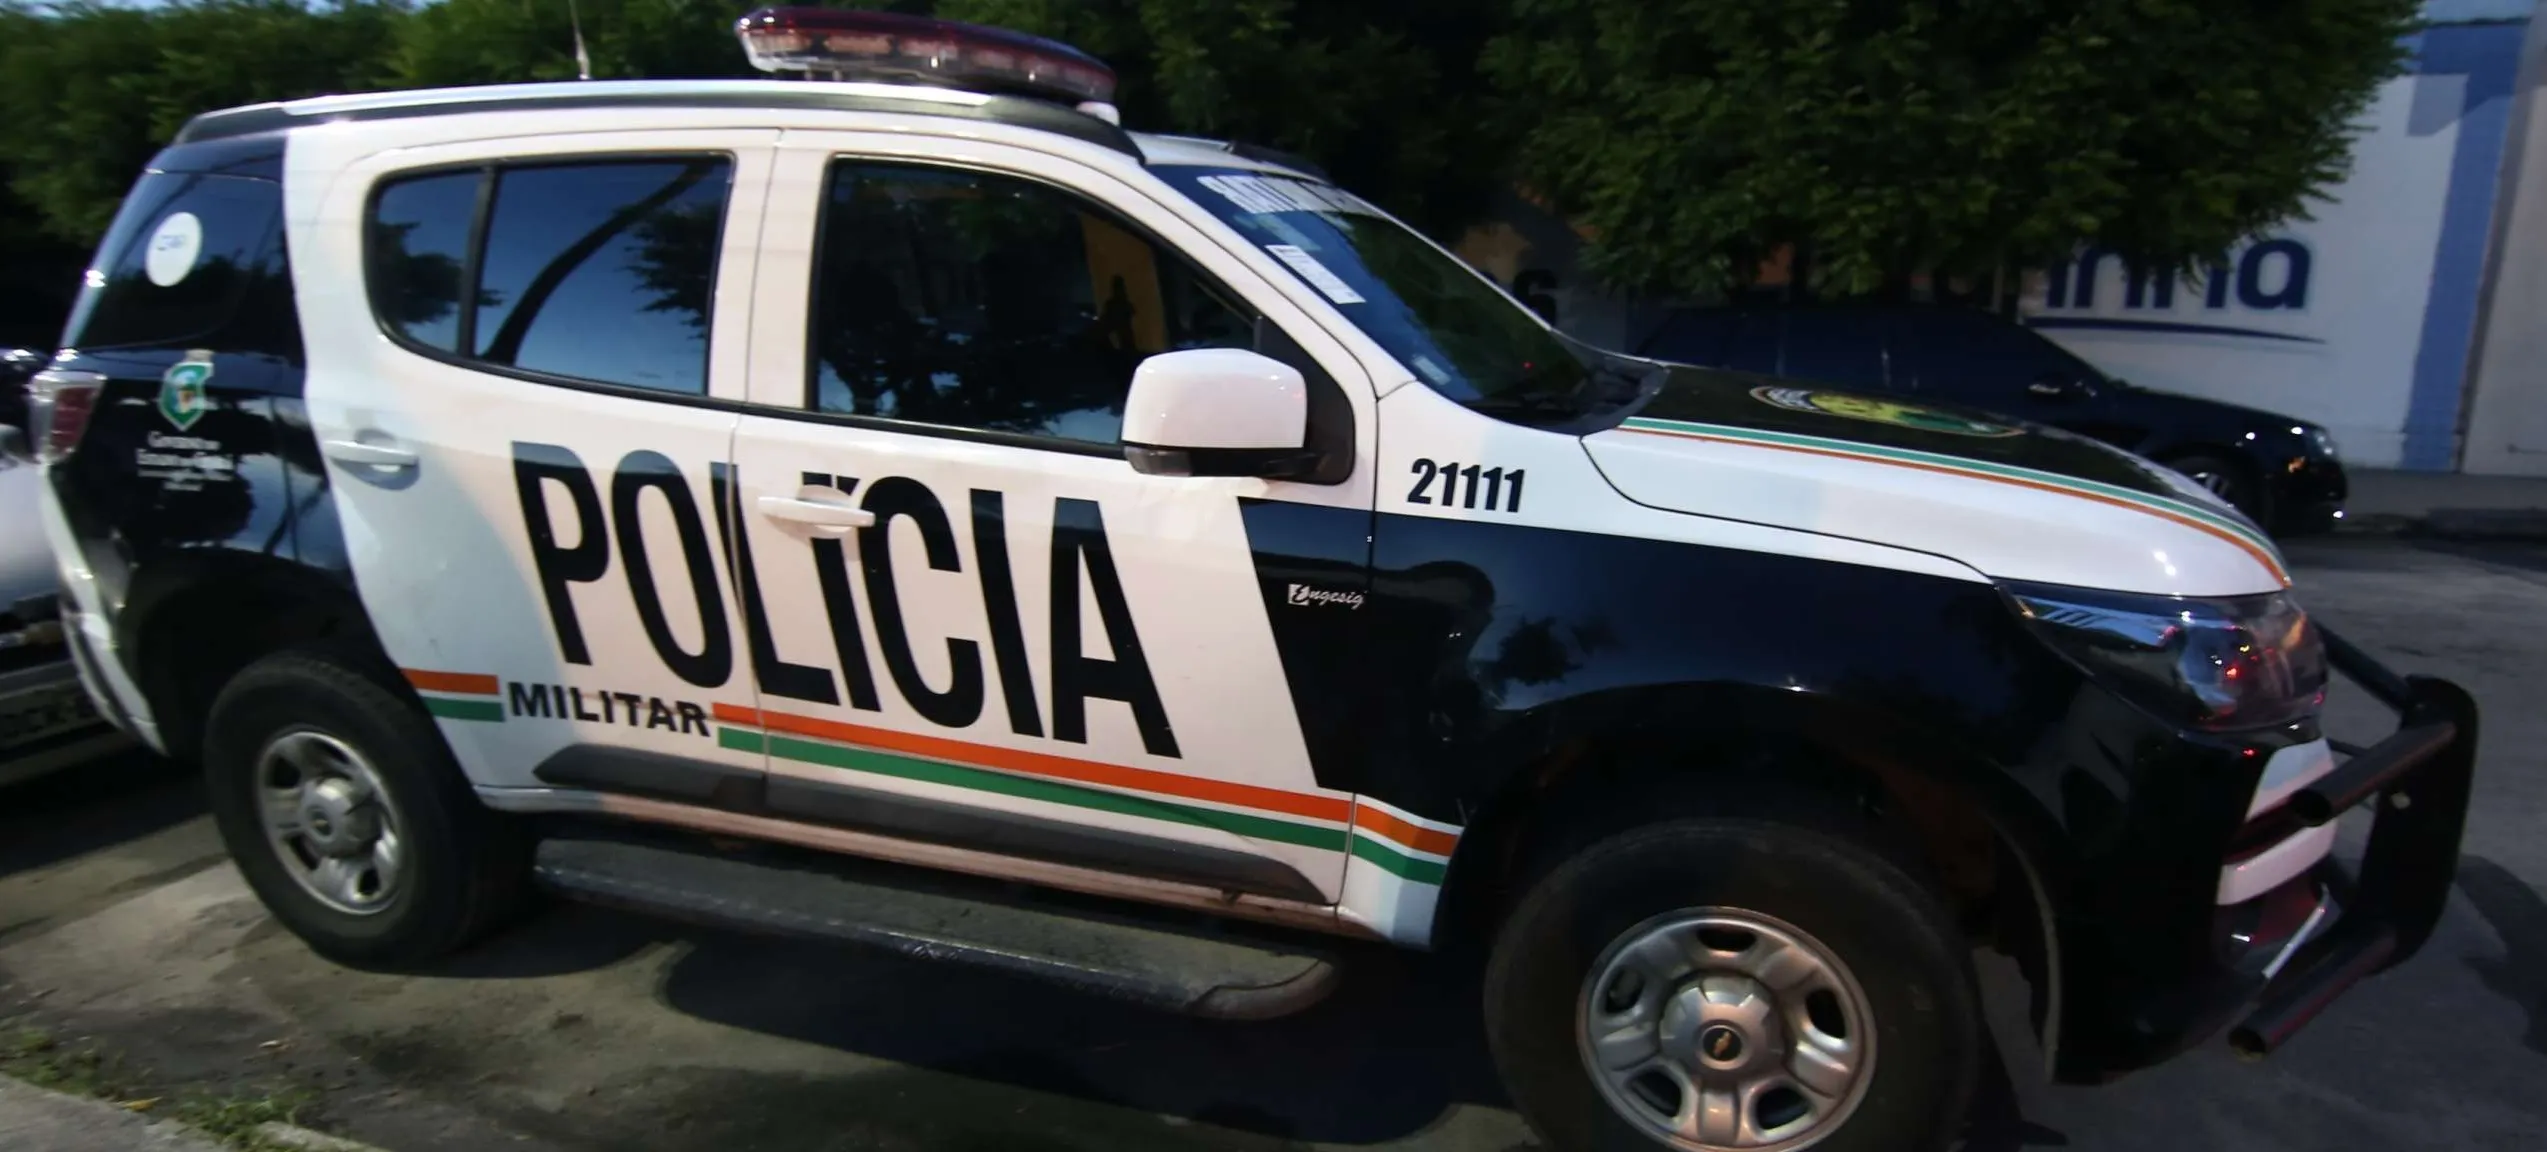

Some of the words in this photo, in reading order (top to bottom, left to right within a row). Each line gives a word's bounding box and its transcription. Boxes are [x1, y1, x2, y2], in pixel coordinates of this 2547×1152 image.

[1406, 458, 1525, 513] 21111
[511, 441, 1182, 759] POLÍCIA
[507, 681, 710, 737] MILITAR
